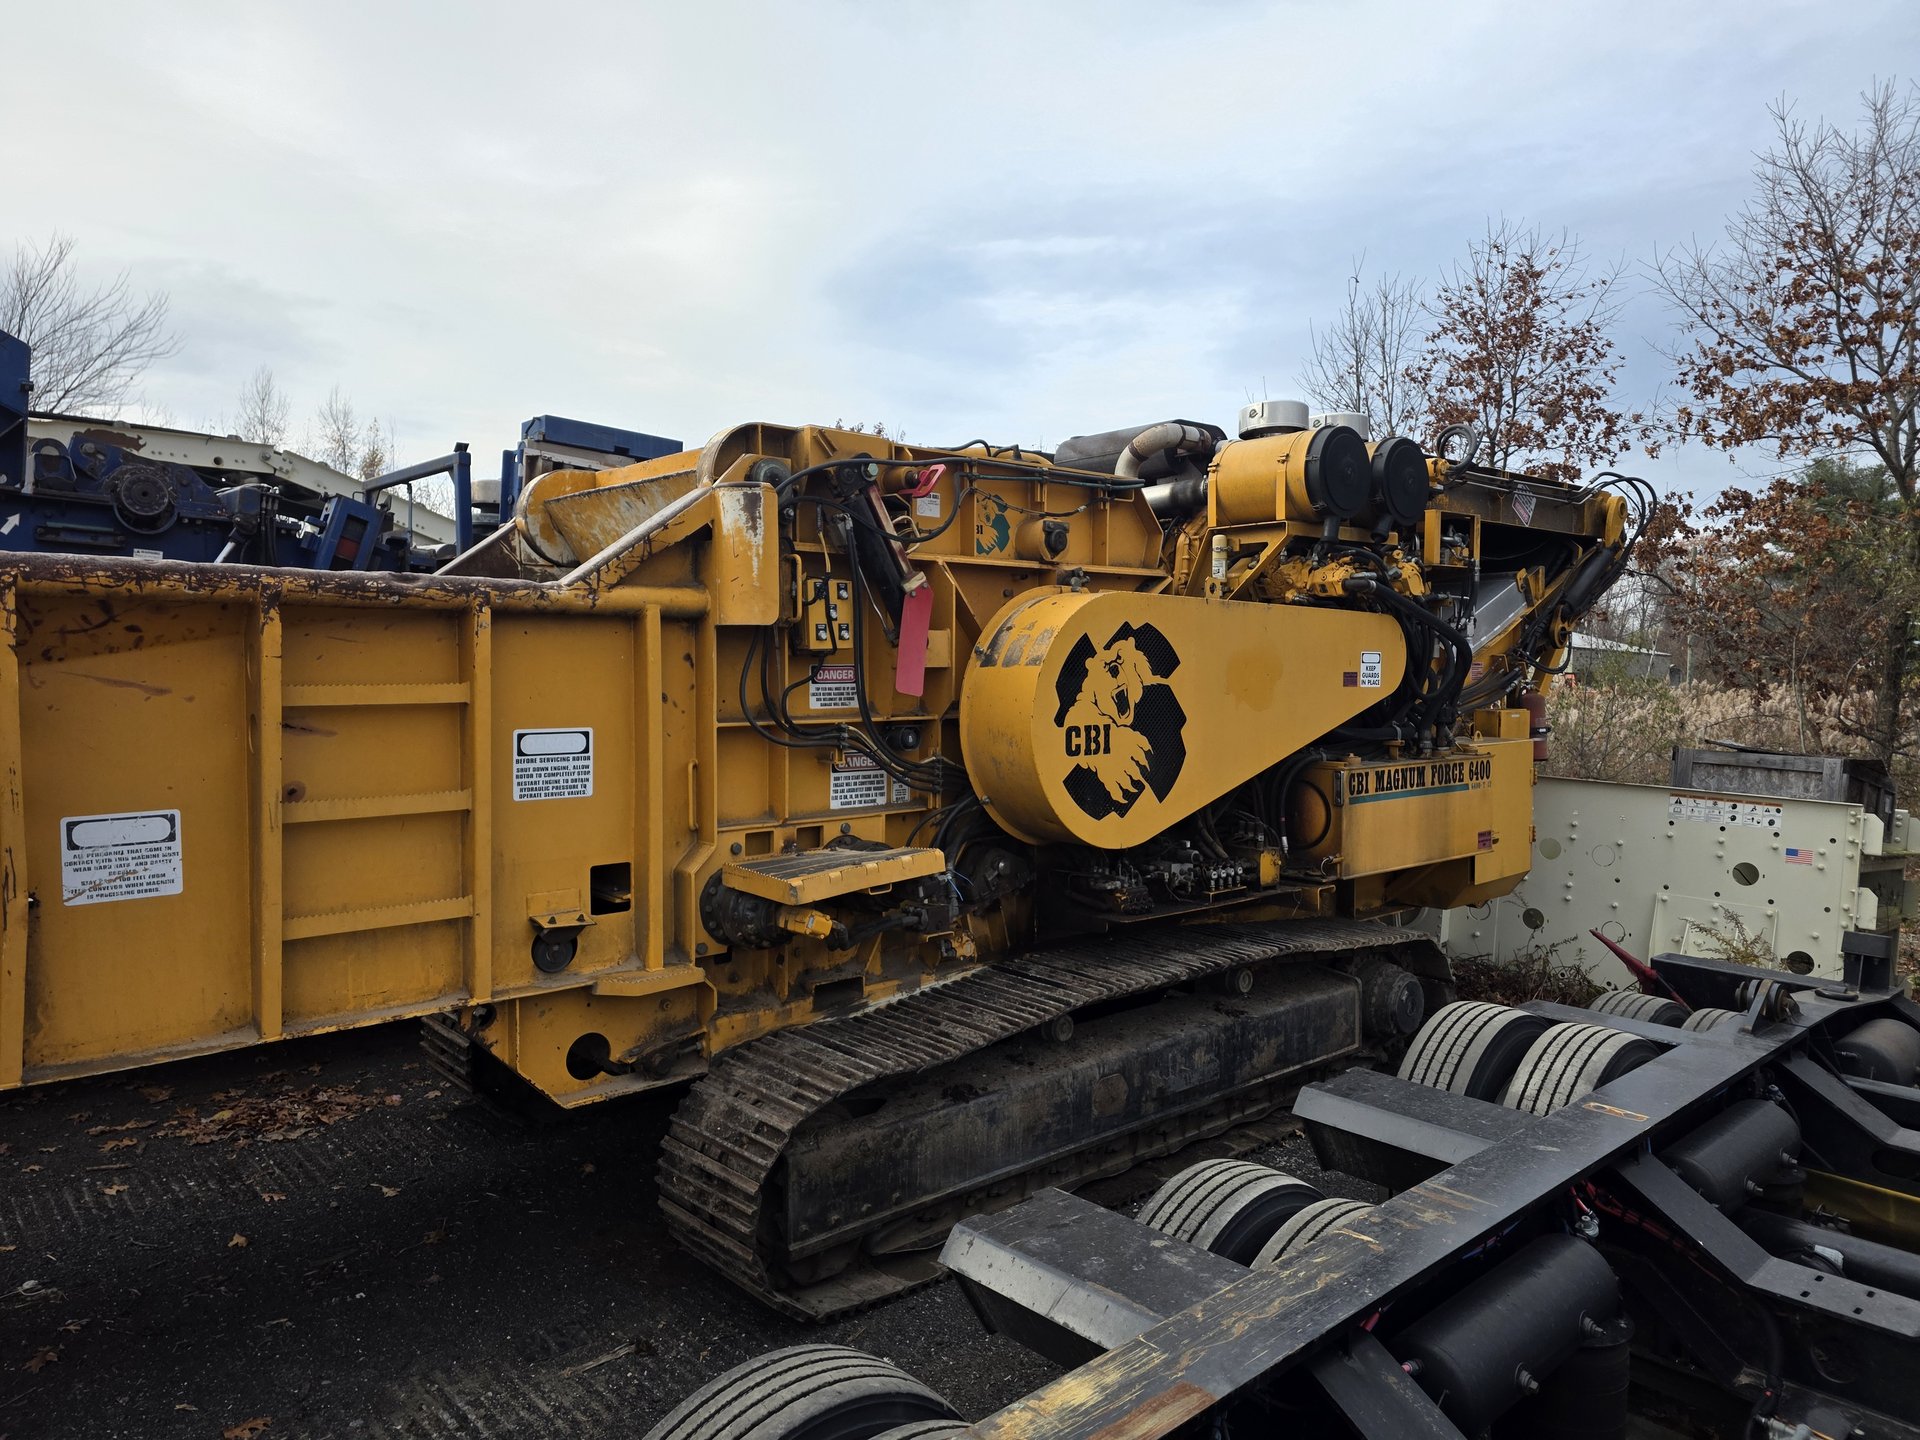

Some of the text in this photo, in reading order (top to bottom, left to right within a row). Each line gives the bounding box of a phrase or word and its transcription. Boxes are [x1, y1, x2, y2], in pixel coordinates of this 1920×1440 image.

[817, 670, 854, 680] DANGER
[1065, 724, 1111, 757] CBI
[839, 757, 876, 768] ANGE
[1349, 760, 1491, 796] CBI MAGNUM FORCE 6400
